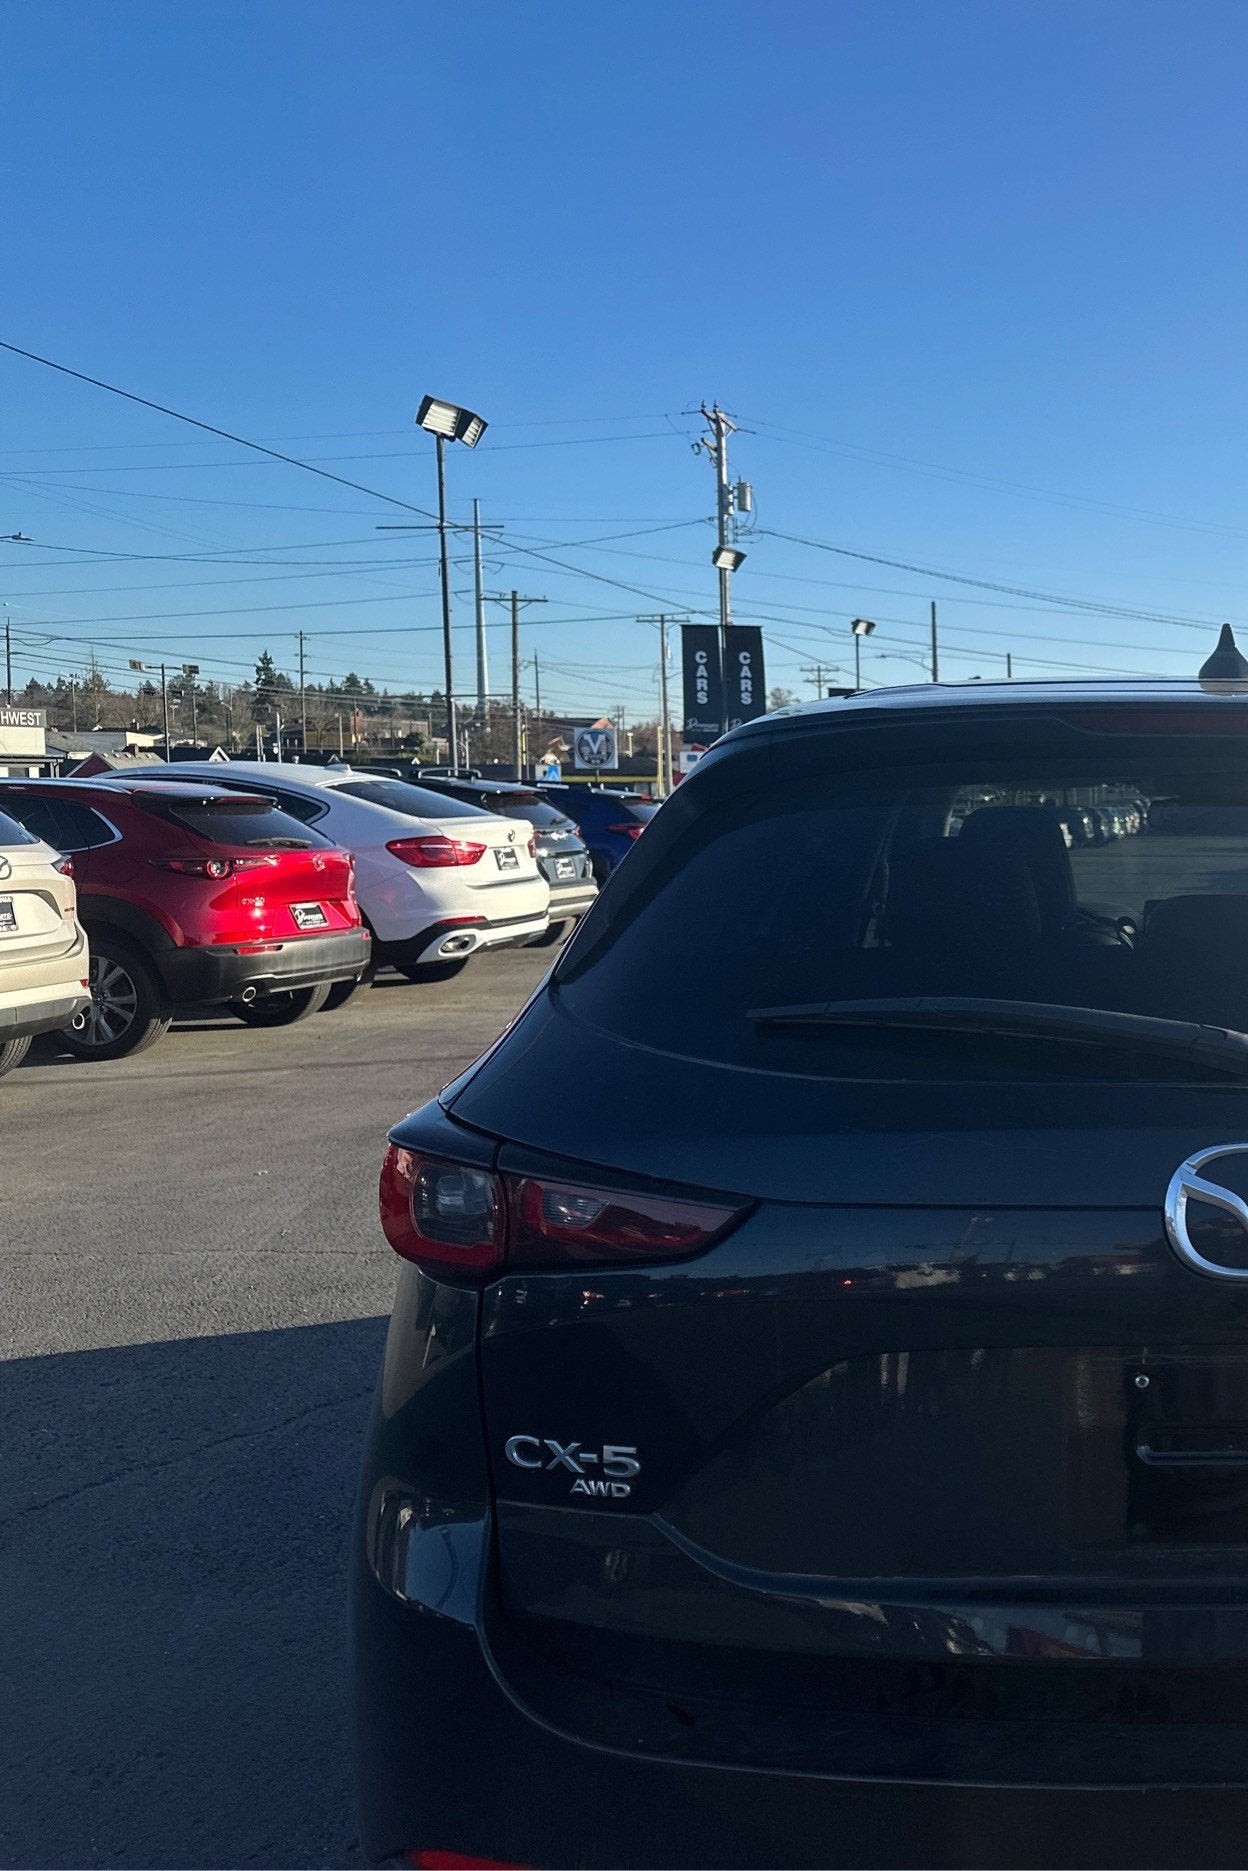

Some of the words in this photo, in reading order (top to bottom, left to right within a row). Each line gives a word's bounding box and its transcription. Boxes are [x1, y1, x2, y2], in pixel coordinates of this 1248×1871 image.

[695, 650, 708, 704] CARS
[738, 651, 752, 705] CARS
[504, 1434, 641, 1478] CX-5
[569, 1479, 632, 1498] AWD
